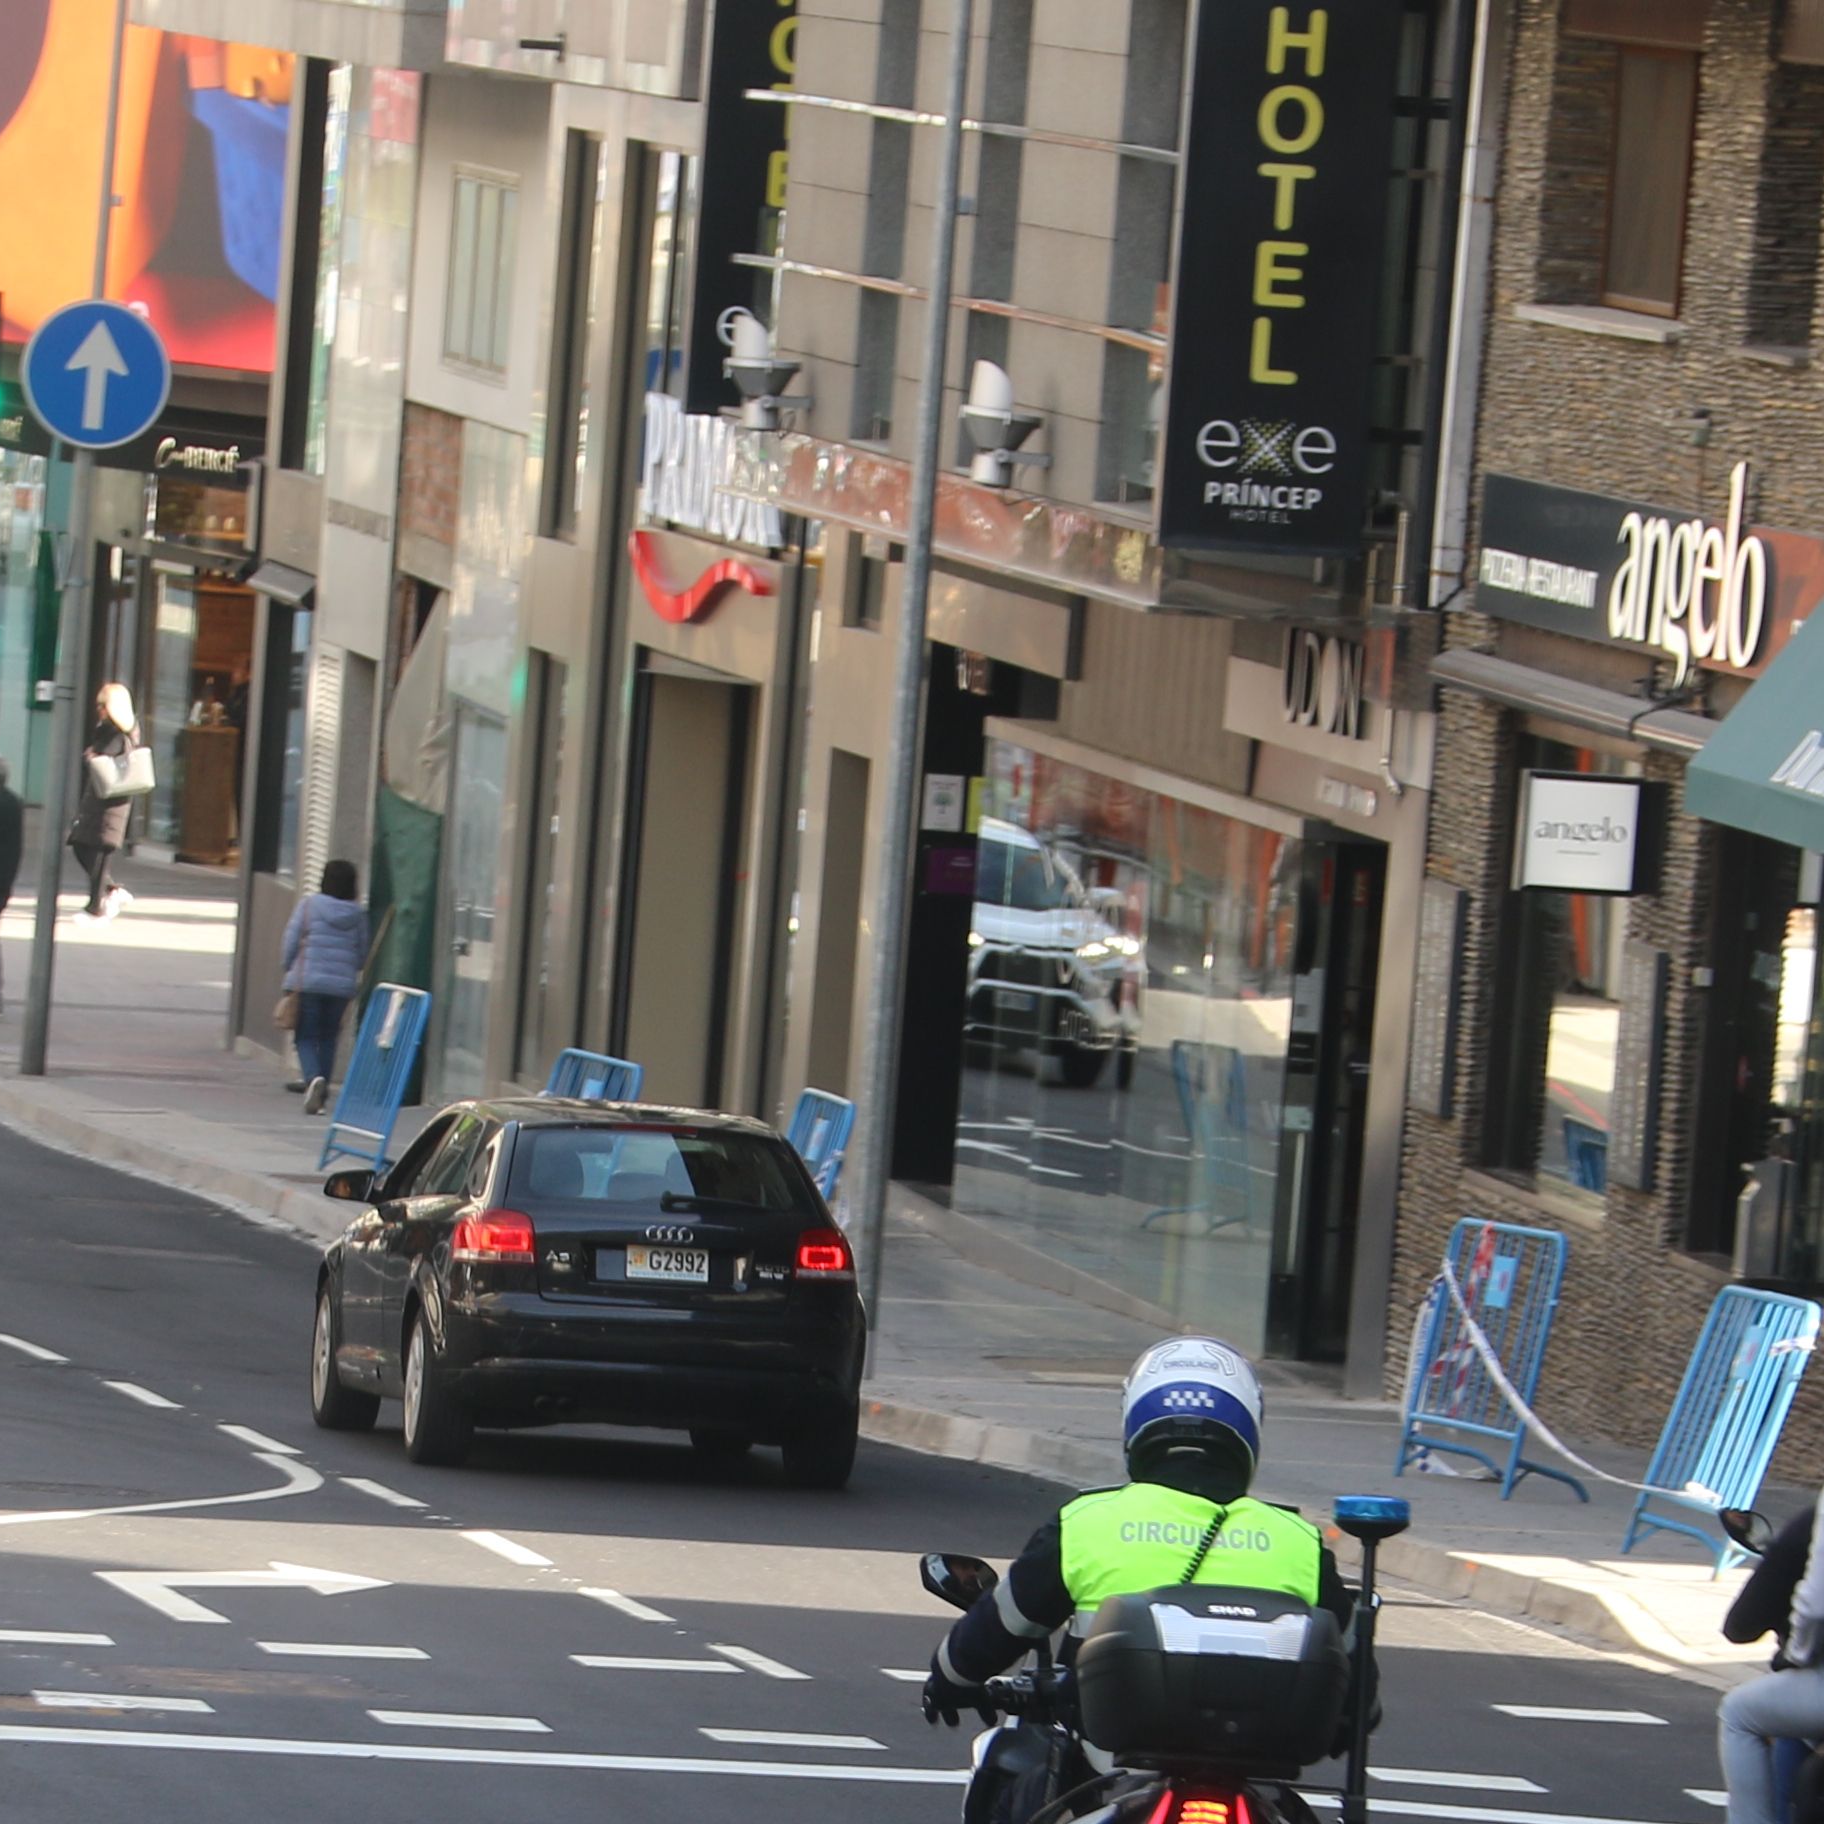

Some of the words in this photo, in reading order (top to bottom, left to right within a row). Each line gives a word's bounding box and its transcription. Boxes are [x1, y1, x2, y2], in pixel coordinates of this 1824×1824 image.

[1249, 6, 1328, 385] HOTEL
[1196, 417, 1337, 476] exe
[1204, 478, 1323, 510] PRÍNCEP
[1229, 509, 1292, 524] HOTEL
[1608, 461, 1766, 689] angelo
[1282, 626, 1364, 740] UDON
[1534, 816, 1628, 843] angelo
[649, 1250, 706, 1274] G2992
[1208, 1604, 1257, 1617] SHAD
